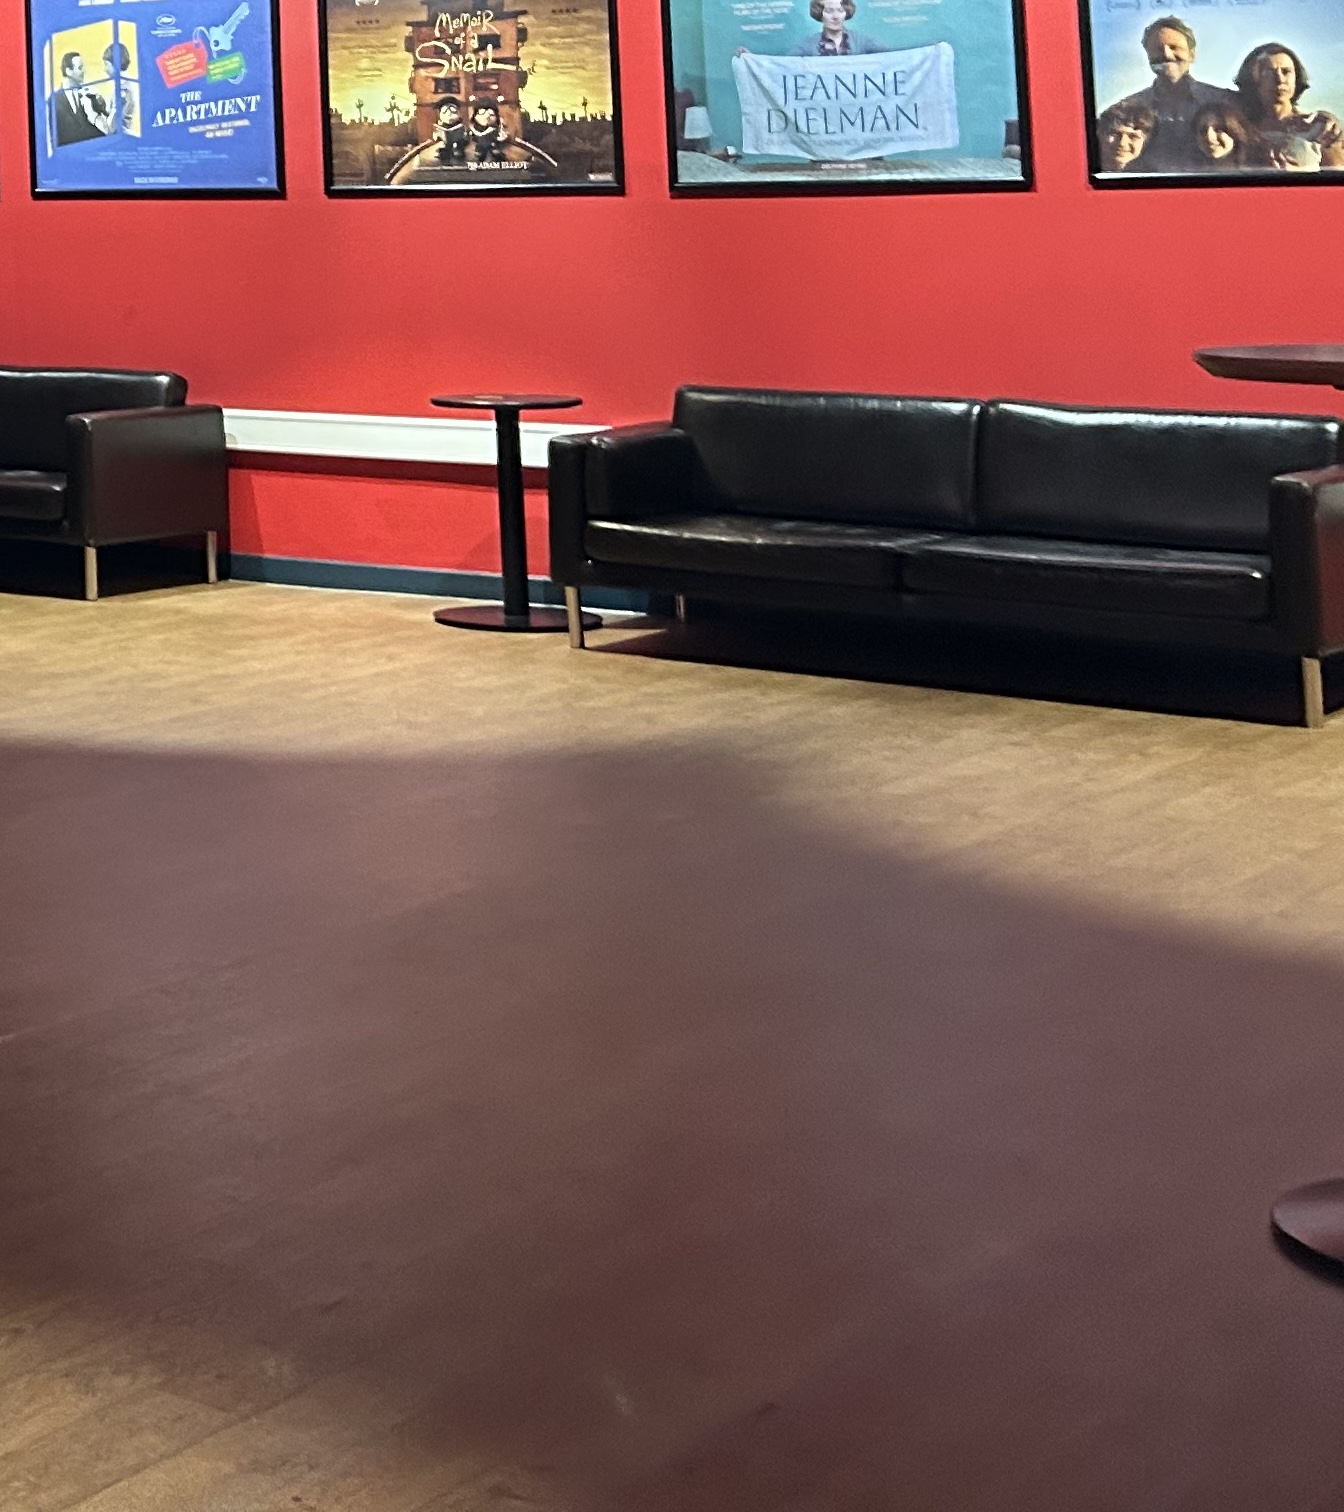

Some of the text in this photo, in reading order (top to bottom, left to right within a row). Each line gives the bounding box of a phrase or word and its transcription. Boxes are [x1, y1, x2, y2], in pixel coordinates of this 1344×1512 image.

[179, 90, 202, 103] THE
[781, 70, 908, 107] JEANNE
[151, 95, 261, 128] APARTMENT
